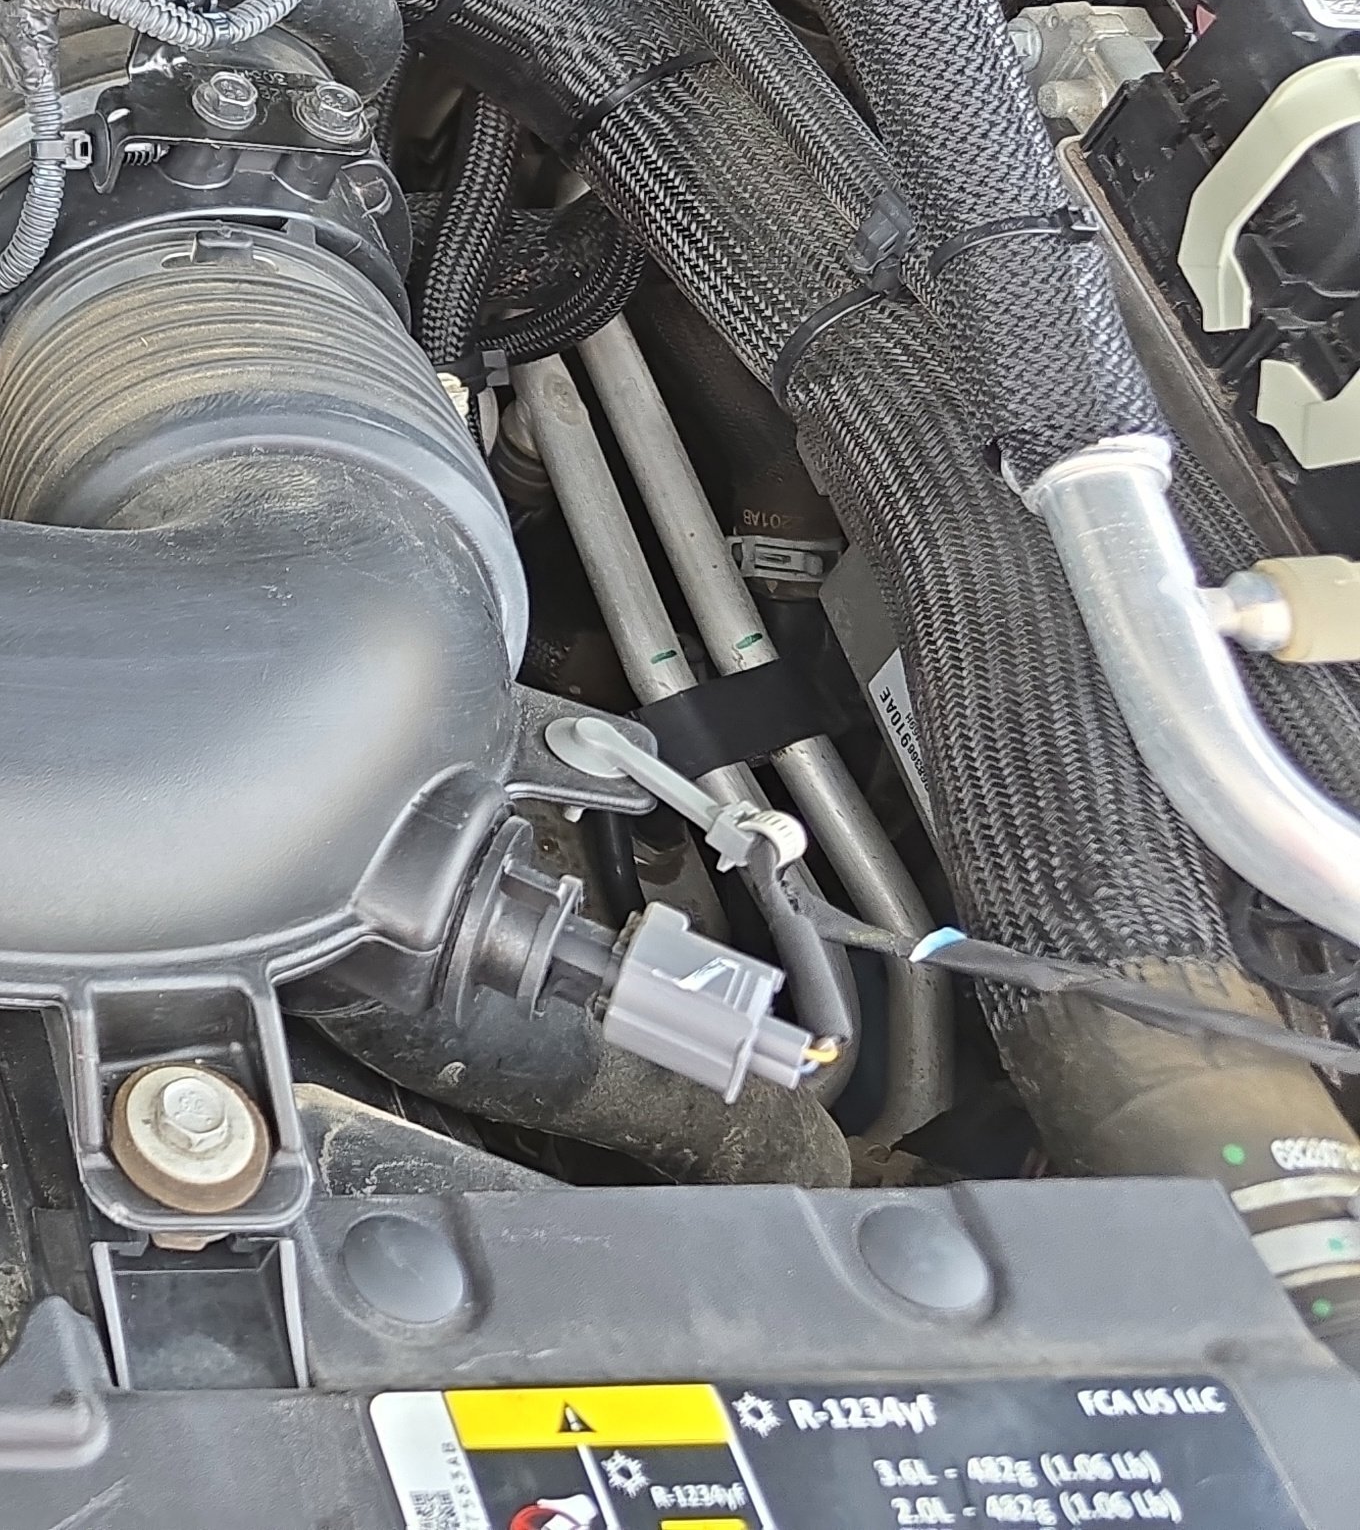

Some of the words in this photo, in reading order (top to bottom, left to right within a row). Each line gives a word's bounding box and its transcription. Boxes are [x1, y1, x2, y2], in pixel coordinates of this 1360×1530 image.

[788, 1393, 939, 1433] R-1234yf
[1077, 1388, 1137, 1417] FCA
[1136, 1387, 1177, 1415] US
[1174, 1386, 1228, 1414] LLC
[873, 1458, 939, 1488] 3.6L
[649, 1482, 747, 1511] R-1234yf
[891, 1496, 956, 1526] 2.0L
